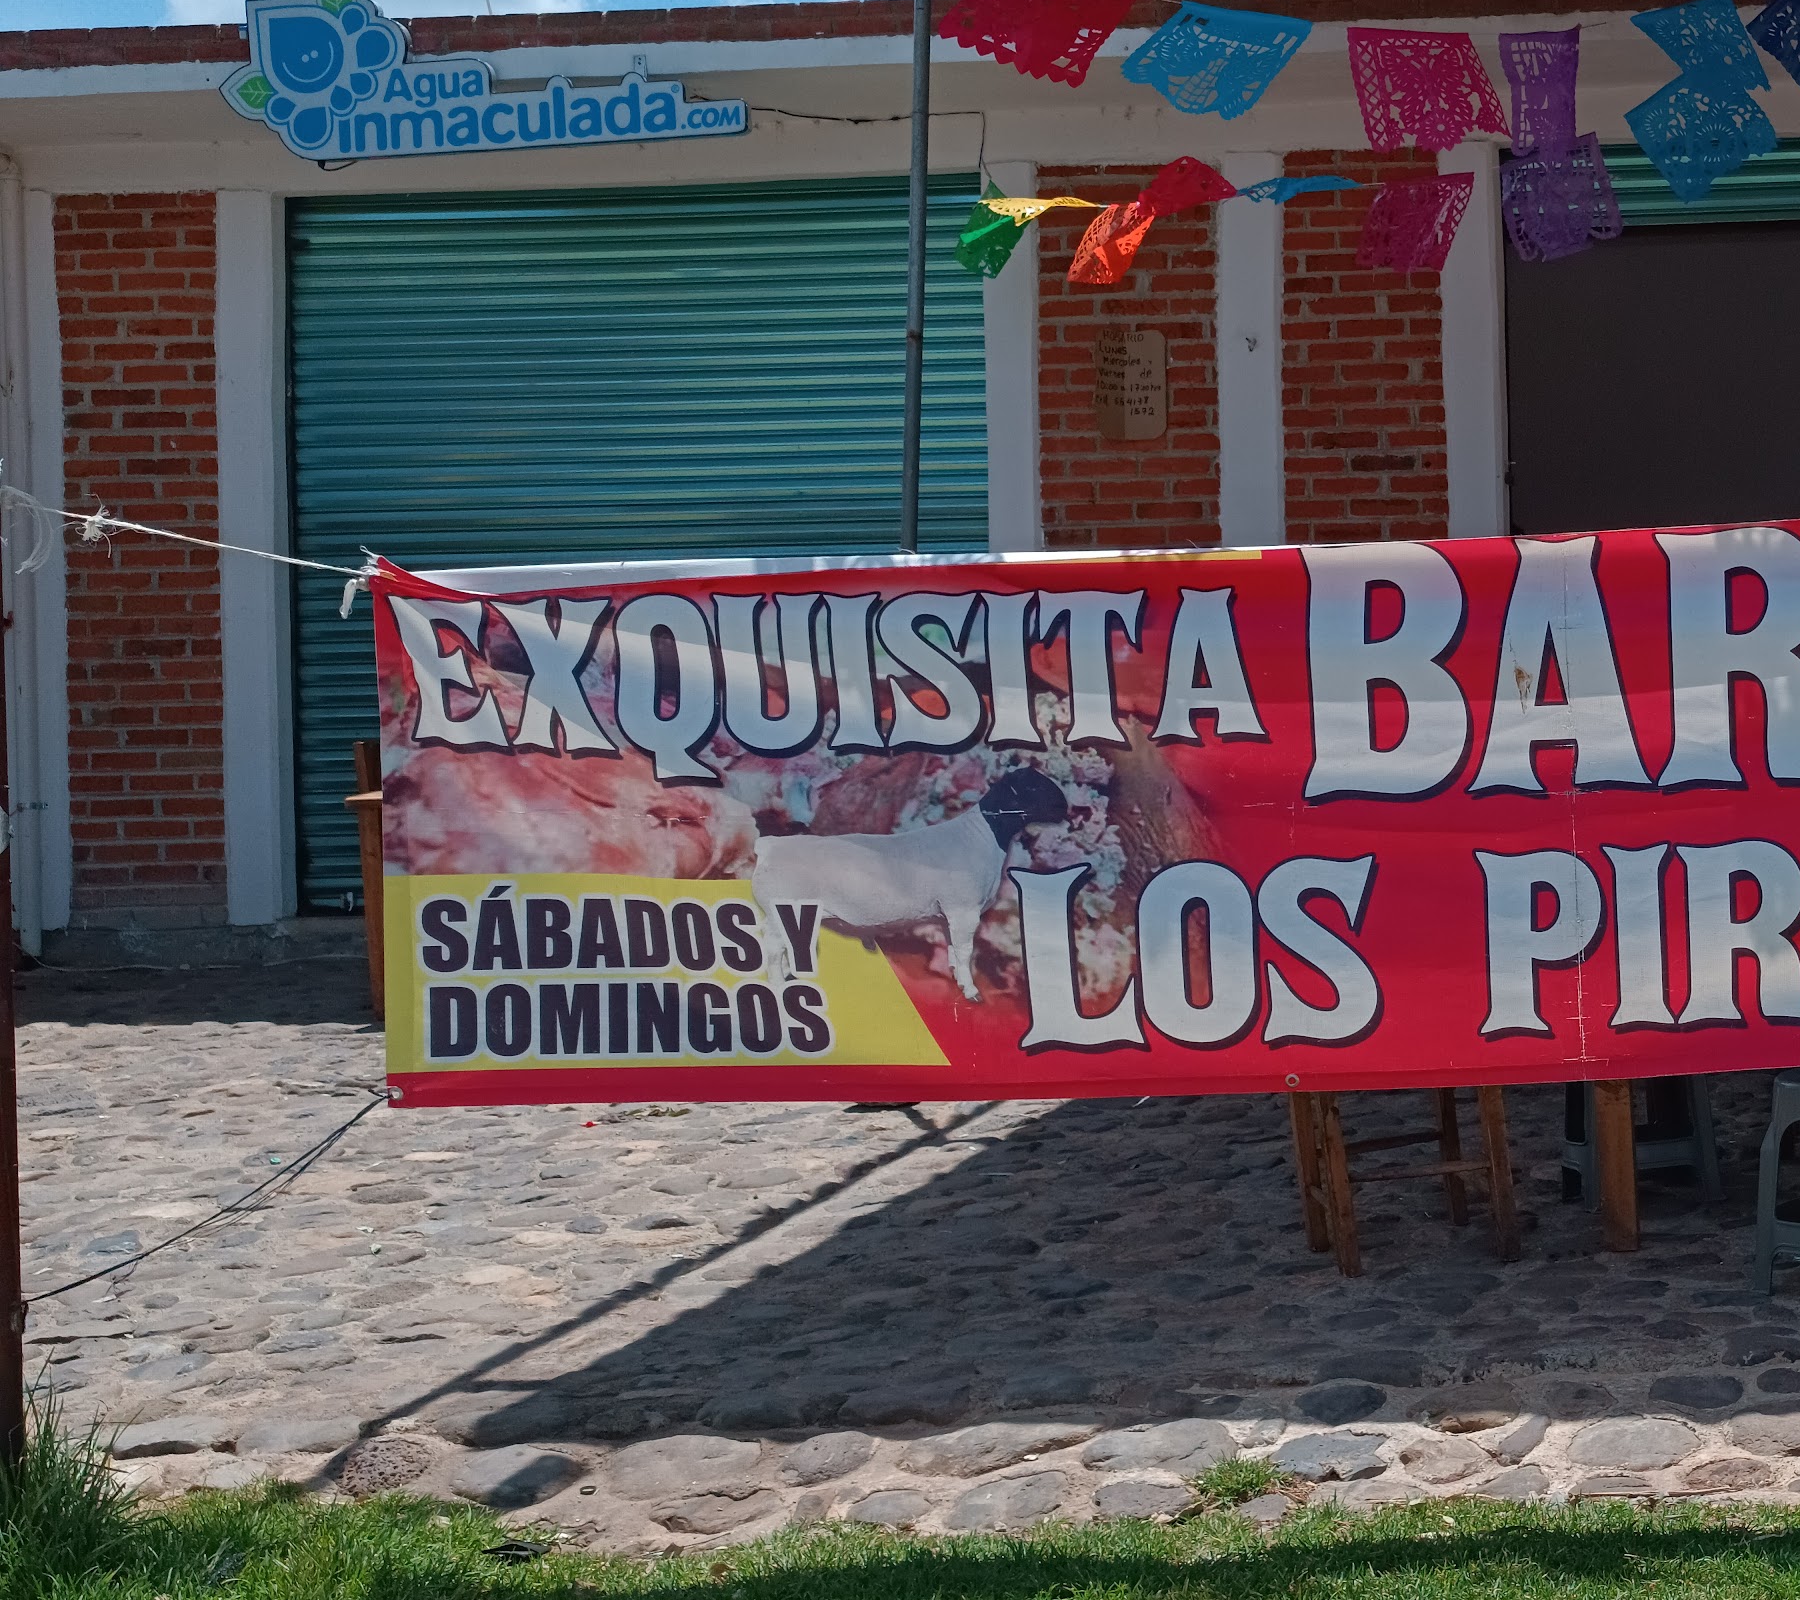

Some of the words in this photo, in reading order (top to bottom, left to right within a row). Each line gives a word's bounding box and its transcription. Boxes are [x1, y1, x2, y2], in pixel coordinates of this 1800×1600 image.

[382, 67, 484, 105] Agua
[388, 585, 1270, 786] EXQUISITA
[420, 884, 764, 973] SÁBADOS
[775, 903, 822, 972] Y
[1008, 855, 1383, 1052] LOS
[429, 981, 832, 1058] DOMINGOS
